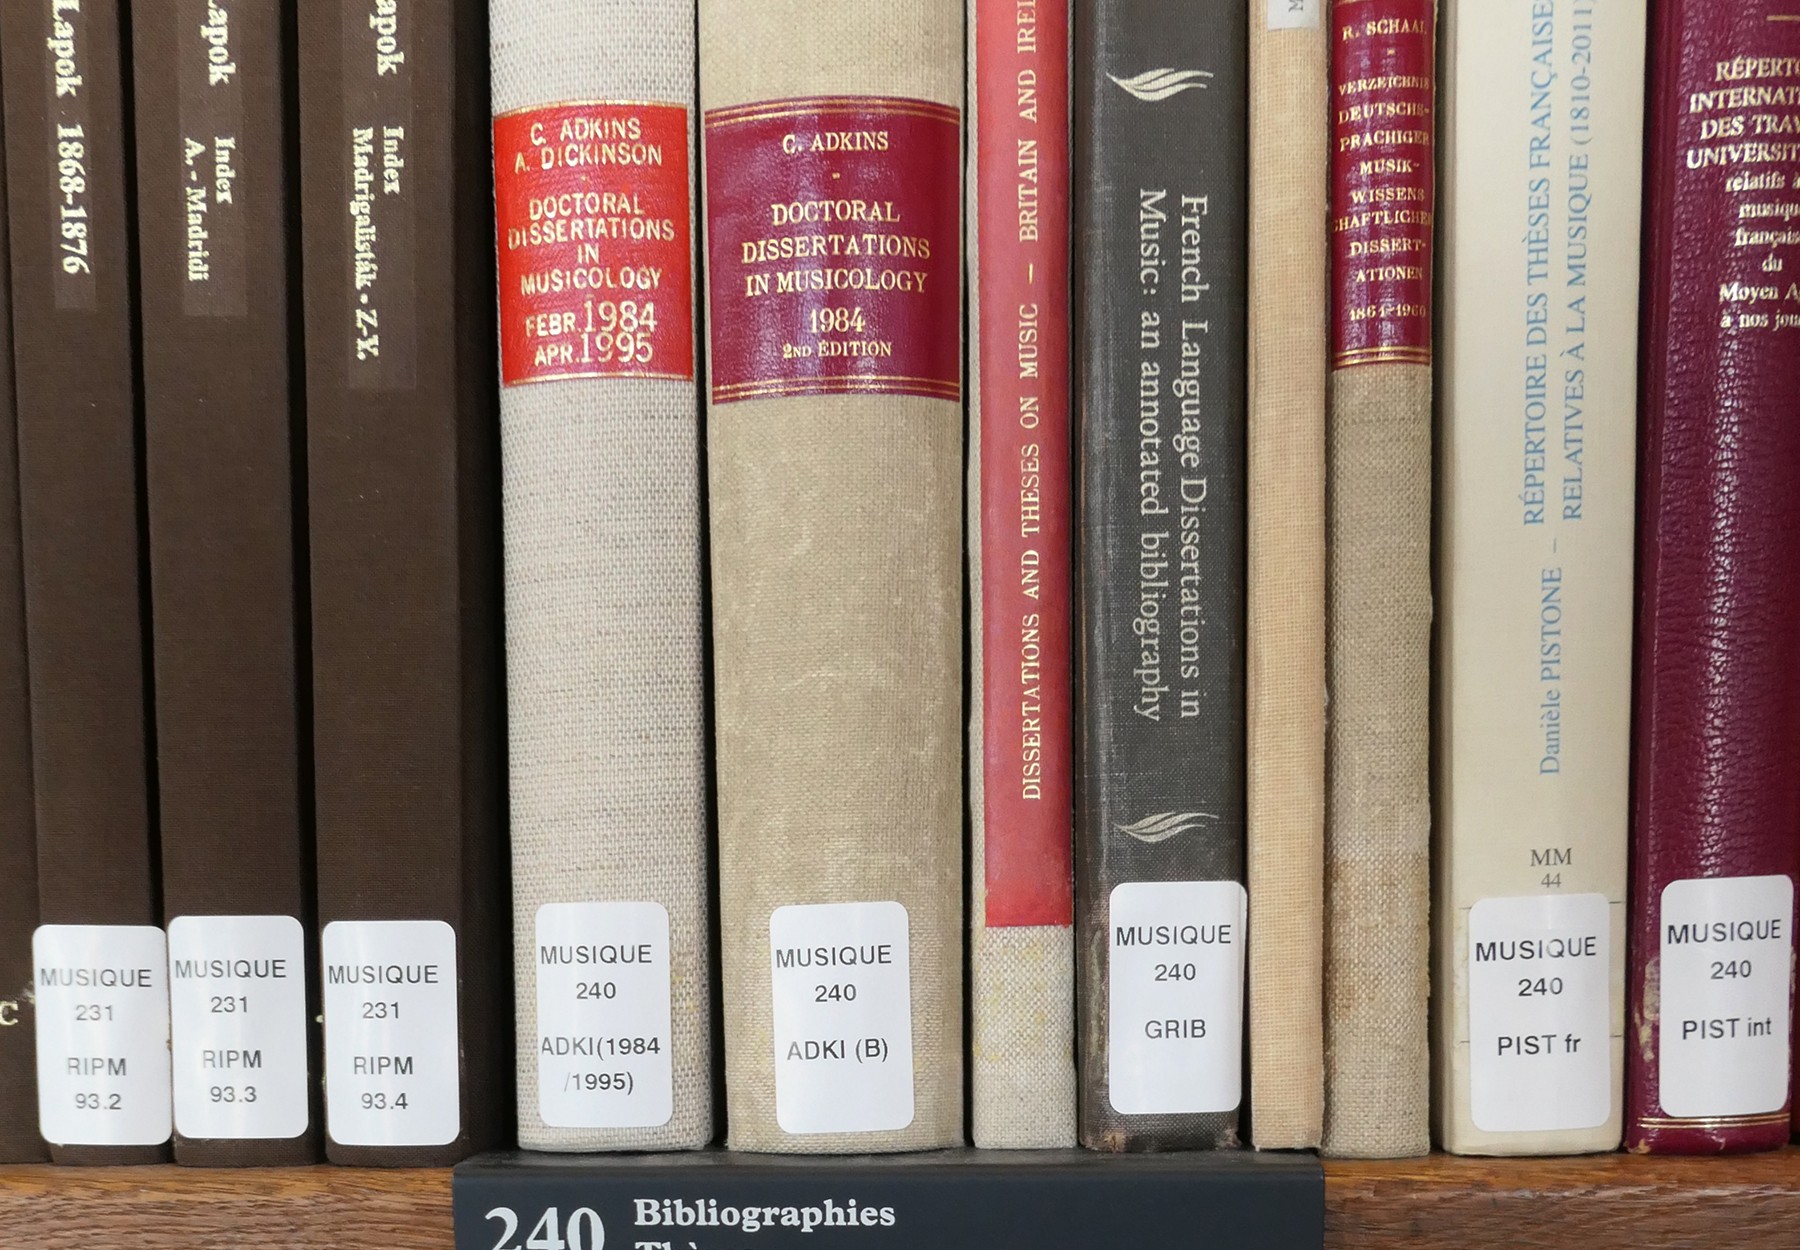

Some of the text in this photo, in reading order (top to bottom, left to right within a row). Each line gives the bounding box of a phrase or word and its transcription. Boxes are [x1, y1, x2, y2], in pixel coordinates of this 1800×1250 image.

[201, 0, 236, 85] apok
[1341, 25, 1360, 41] R.
[1017, 69, 1038, 124] AND
[1338, 75, 1430, 96] VERZEICHNIS
[559, 116, 642, 142] ADKINS
[1700, 115, 1745, 140] DES
[782, 131, 889, 154] C. ADKINS
[1339, 130, 1430, 152] PRACHIGER
[214, 135, 236, 205] Index
[382, 125, 405, 195] Index
[514, 144, 663, 174] A. DICKINSON
[56, 123, 91, 275] 1868-1876
[1018, 138, 1039, 243] BRITAIN
[1351, 187, 1426, 205] WISSENS
[529, 192, 645, 221] DOCTORAL
[770, 198, 901, 228] DOCTORAL
[1566, 154, 1593, 287] MUSIQUE
[508, 217, 676, 249] DISSERTATIONS
[577, 242, 600, 265] IN
[740, 233, 932, 264] DISSERTATIONS
[1355, 265, 1424, 283] ATIONEN
[1761, 252, 1783, 272] du
[520, 266, 663, 295] MUSICOLOGY
[745, 268, 928, 297] IN MUSICOLOGY
[1718, 281, 1779, 304] Moyen
[809, 306, 866, 333] 1984
[1565, 295, 1586, 334] LA
[1739, 313, 1769, 329] nos
[1018, 303, 1039, 381] MUSIC
[1518, 177, 1551, 526] RÉPERTOIRE DES THÈSES
[1018, 396, 1040, 430] ON
[1132, 187, 1170, 722] Music: an annotated bibliography
[1172, 193, 1211, 719] French Language Dissertations in
[1562, 368, 1585, 521] RELATIVES
[1019, 441, 1042, 539] THESES
[1021, 547, 1041, 601] AND
[1539, 566, 1562, 777] Danièle PISTONE
[1021, 611, 1042, 801] DISSERTATIONS
[1528, 847, 1574, 868] MM
[1540, 873, 1562, 889] 44
[1116, 924, 1232, 947] MUSIQUE
[1667, 919, 1782, 945] MUSIQUE
[540, 944, 653, 966] MUSIQUE
[775, 944, 892, 969] MUSIQUE
[1475, 936, 1597, 962] MUSIQUE
[39, 967, 153, 989] MUSIQUE
[174, 958, 288, 980] MUSIQUE
[328, 964, 439, 985] MUSIQUE
[1154, 963, 1197, 982] 240
[1710, 959, 1753, 980] 240
[575, 982, 617, 1001] 240
[814, 983, 857, 1003] 240
[1517, 977, 1564, 998] 240
[75, 1004, 114, 1022] 231
[210, 996, 249, 1014] 231
[361, 1001, 401, 1020] 231
[1144, 1019, 1206, 1039] GRIB
[1682, 1016, 1773, 1040] PIST int
[786, 1037, 890, 1065] ADKI (B)
[1497, 1032, 1582, 1056] PIST fr
[66, 1057, 128, 1077] RIPM
[202, 1049, 262, 1070] RIPM
[353, 1056, 414, 1076] RIPM
[209, 1086, 258, 1104] 93.3
[563, 1071, 635, 1097] /1995)
[74, 1093, 122, 1111] 93.2
[360, 1092, 409, 1111] 93.4
[632, 1198, 897, 1233] Bibliographies
